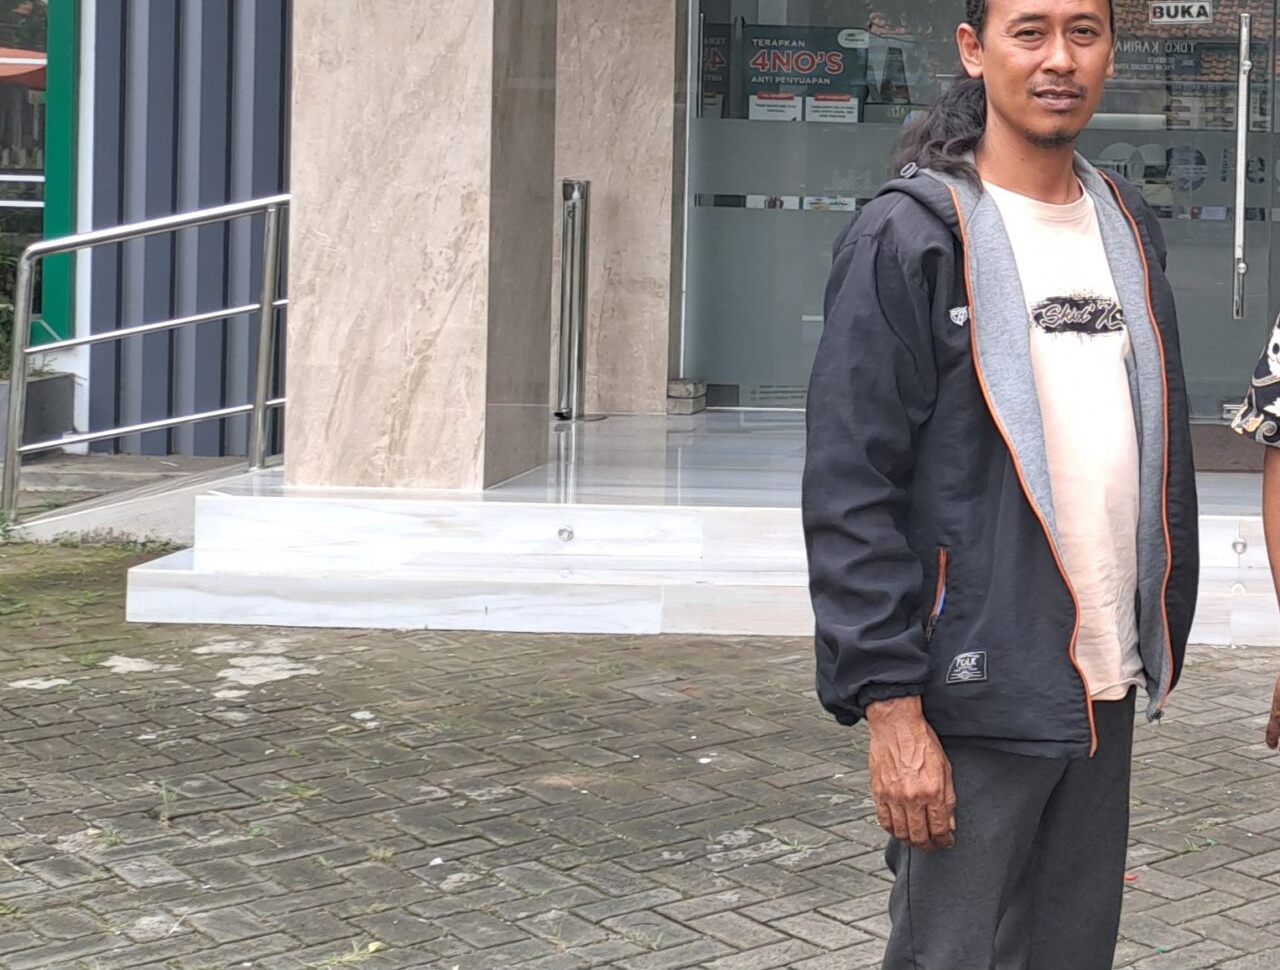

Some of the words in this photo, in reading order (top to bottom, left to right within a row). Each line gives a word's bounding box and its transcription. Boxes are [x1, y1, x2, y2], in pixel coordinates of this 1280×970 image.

[1152, 5, 1209, 19] BUKA
[752, 38, 806, 48] TERAPKAN
[749, 49, 844, 75] 4NO'S
[751, 75, 774, 83] ANTI
[775, 76, 831, 85] PENYUAPAN
